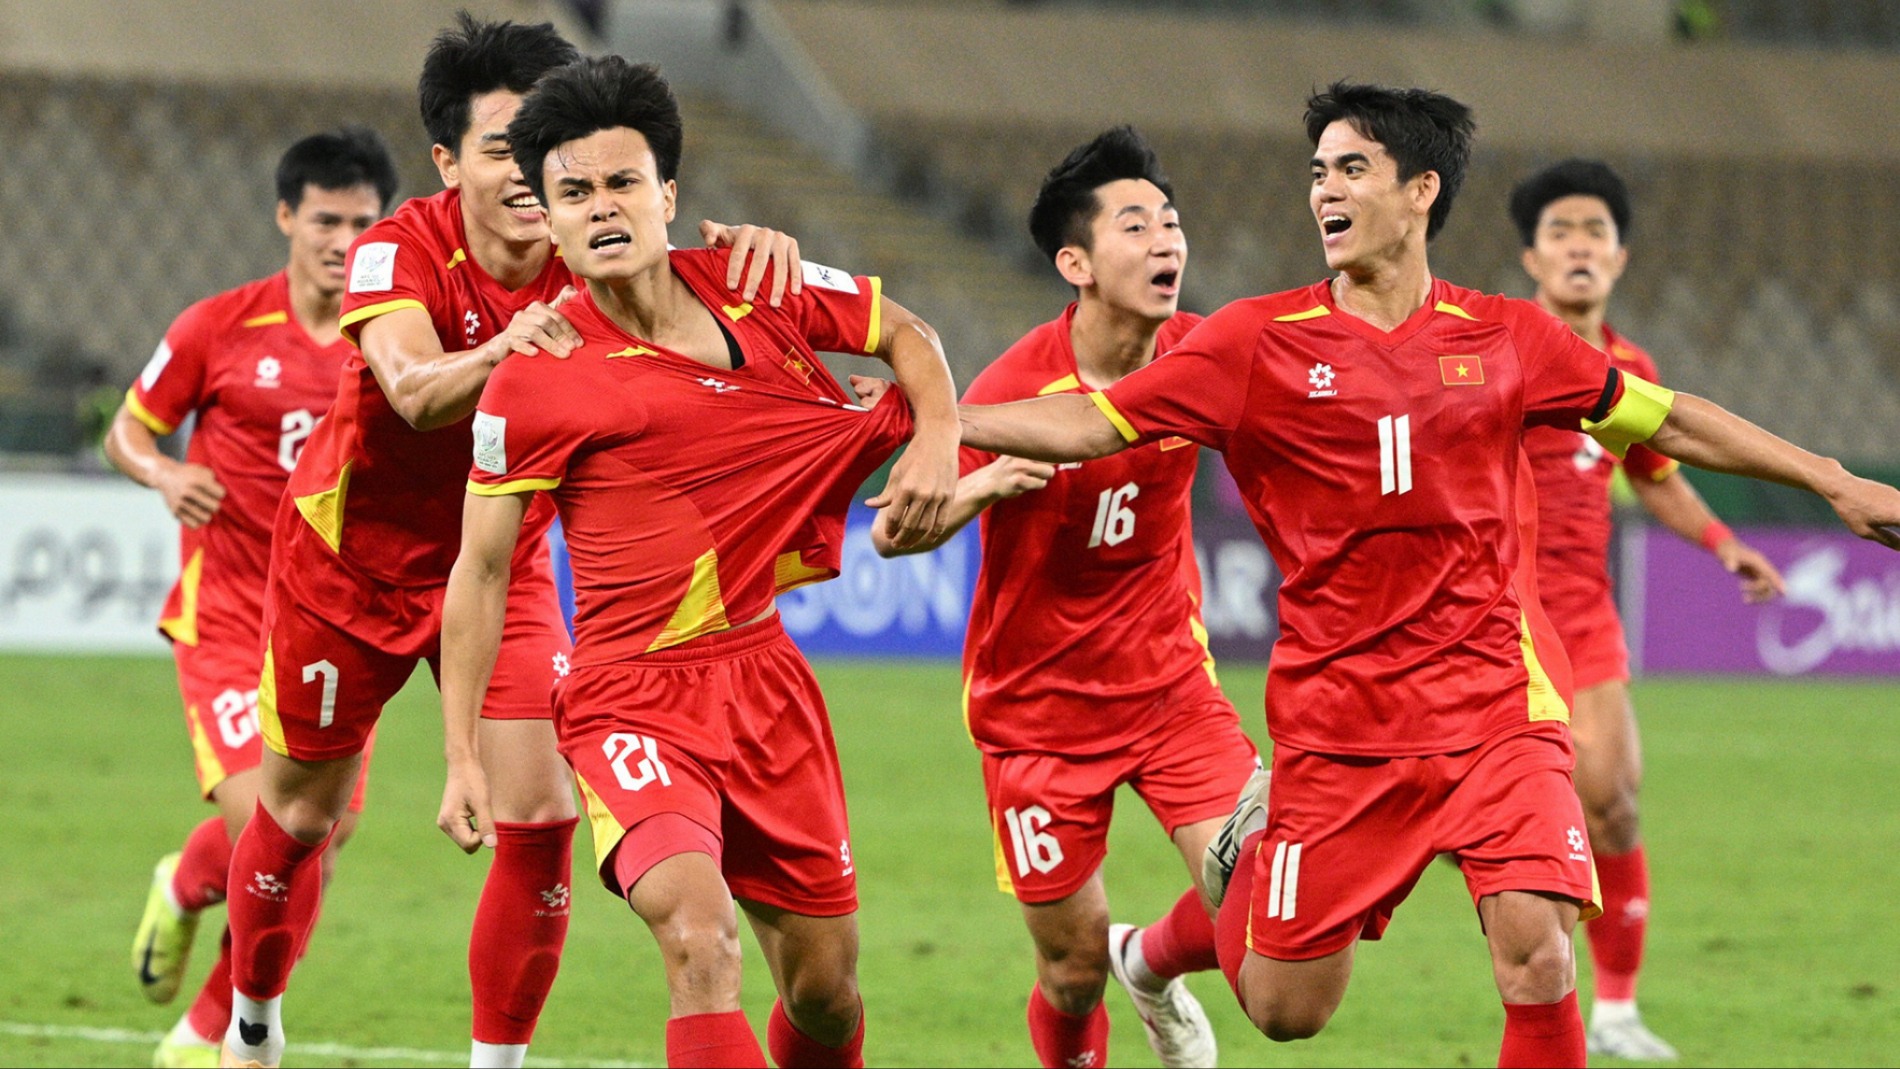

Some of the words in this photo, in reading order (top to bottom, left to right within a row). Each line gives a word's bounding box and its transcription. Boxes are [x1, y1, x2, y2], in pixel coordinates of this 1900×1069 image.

[278, 408, 325, 473] 2
[1377, 413, 1413, 496] 11
[1087, 481, 1139, 549] 16
[302, 659, 339, 729] 7
[601, 732, 673, 792] 21
[1004, 804, 1064, 878] 16
[1267, 840, 1303, 921] 11
